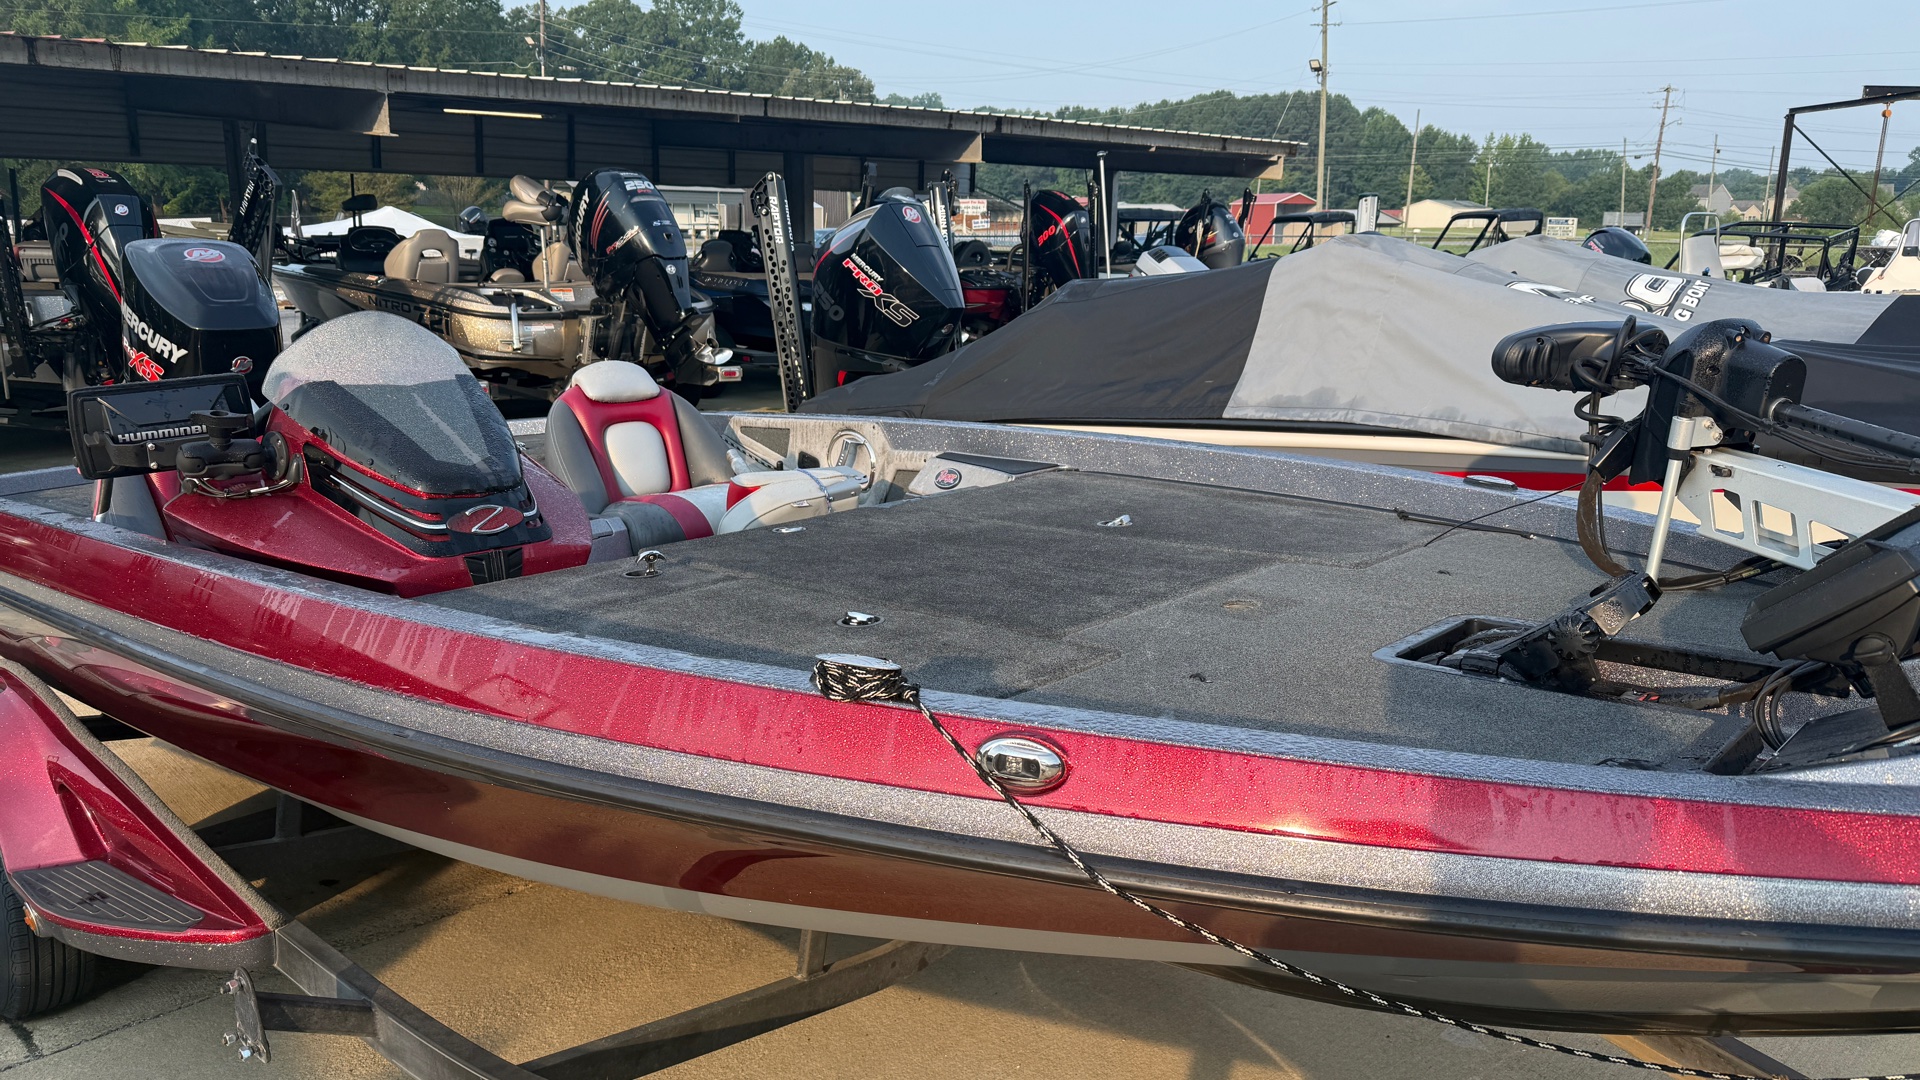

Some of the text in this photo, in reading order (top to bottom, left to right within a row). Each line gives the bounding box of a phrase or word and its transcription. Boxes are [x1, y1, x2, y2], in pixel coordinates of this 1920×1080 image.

[624, 180, 655, 191] 250
[575, 187, 590, 271] MERCURY
[768, 196, 784, 244] RAPTOR
[1037, 225, 1056, 247] 300
[850, 252, 884, 282] MERCURY
[368, 295, 412, 313] NITRO
[813, 281, 845, 321] 250
[842, 257, 920, 328] PRO XS
[1684, 279, 1712, 308] BOAT
[121, 296, 189, 364] MERCURY
[128, 351, 165, 382] XS
[117, 424, 207, 443] HUMMINBI
